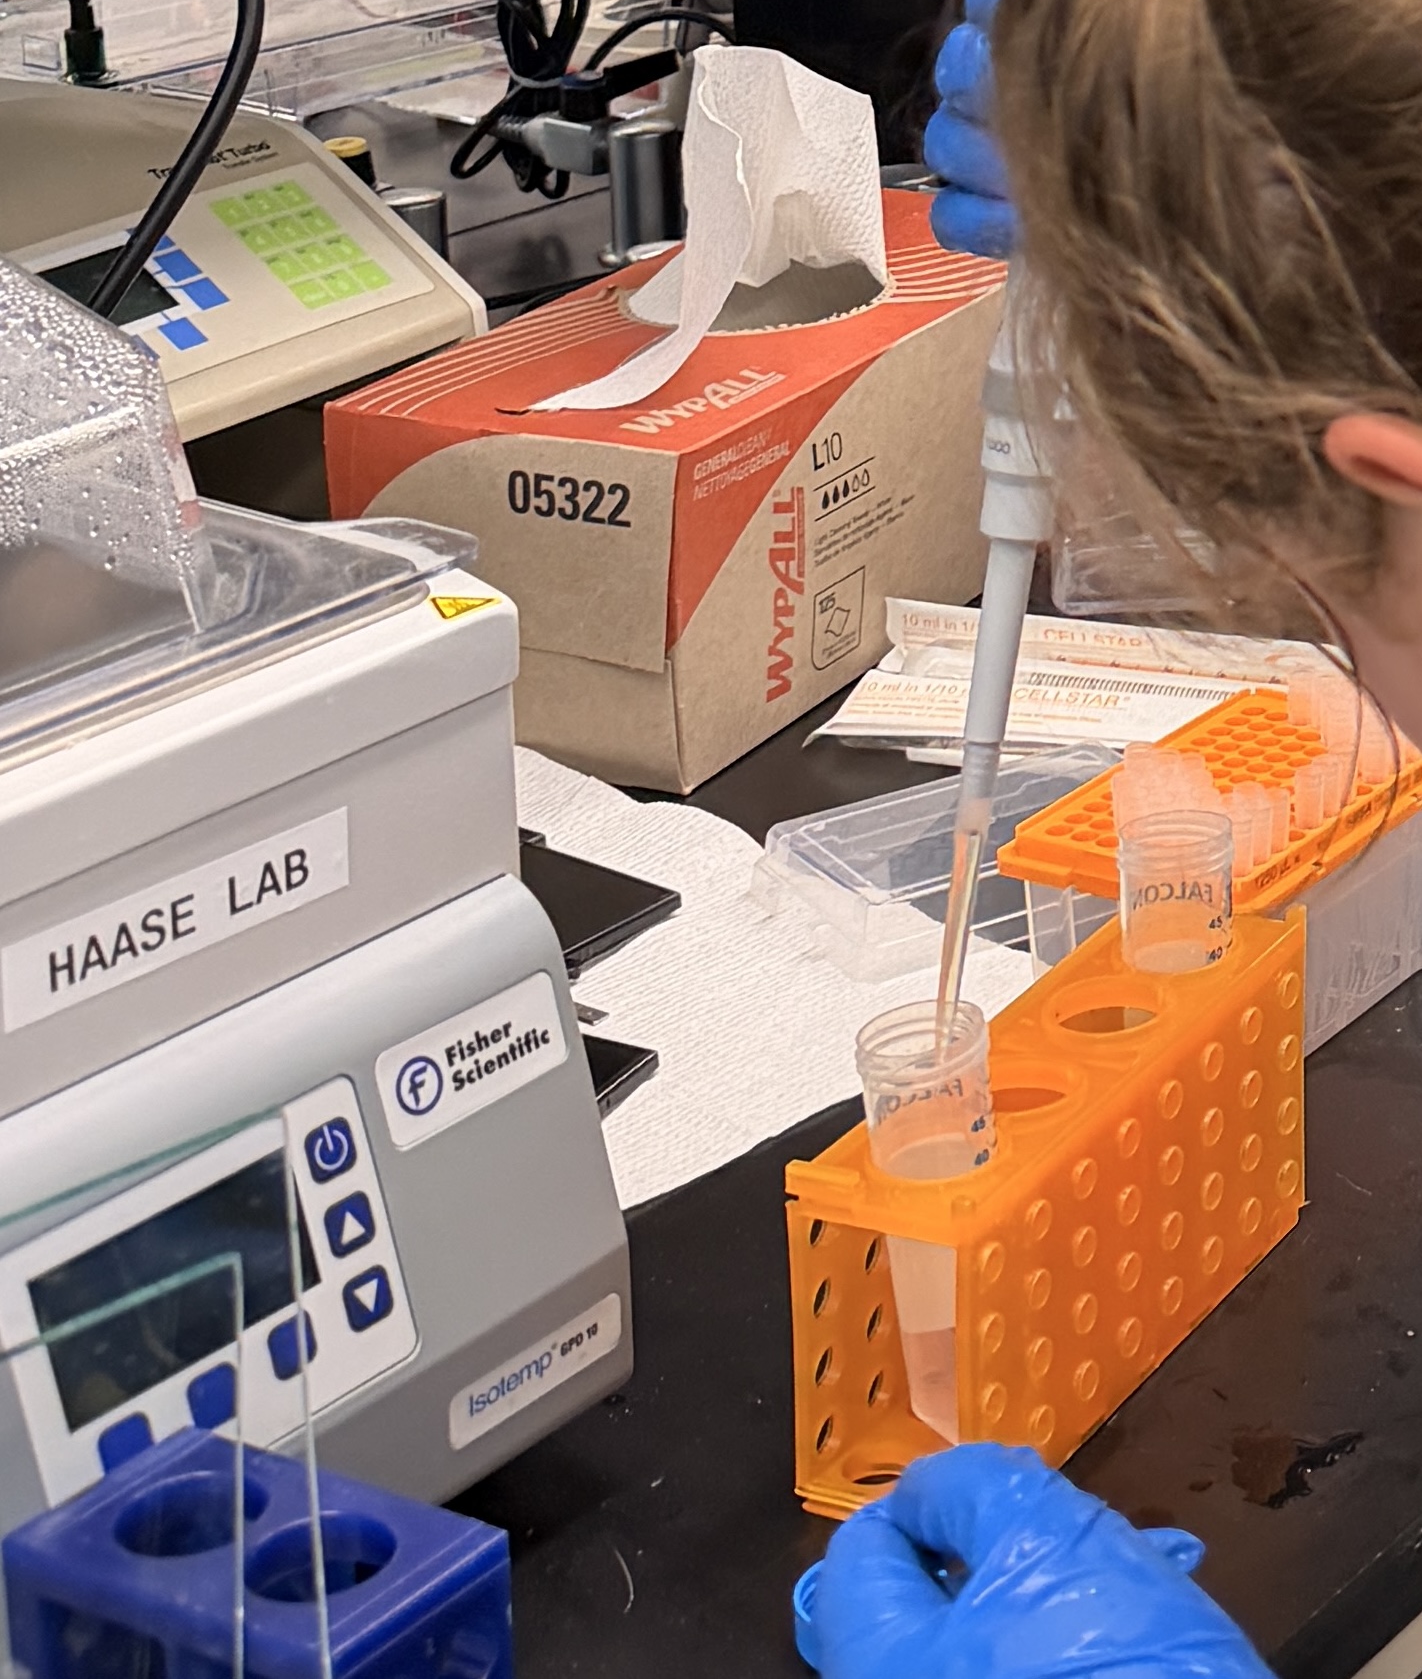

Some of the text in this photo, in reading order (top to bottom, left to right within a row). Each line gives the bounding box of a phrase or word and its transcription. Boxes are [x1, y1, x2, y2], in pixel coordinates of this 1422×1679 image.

[812, 431, 843, 472] L10
[508, 469, 632, 529] 05322
[903, 612, 919, 627] 10
[48, 847, 310, 994] HAASE LAB
[445, 1021, 513, 1068] Fisher
[451, 1028, 551, 1093] Scientific
[468, 1322, 598, 1418] Isotemp GPD 10
